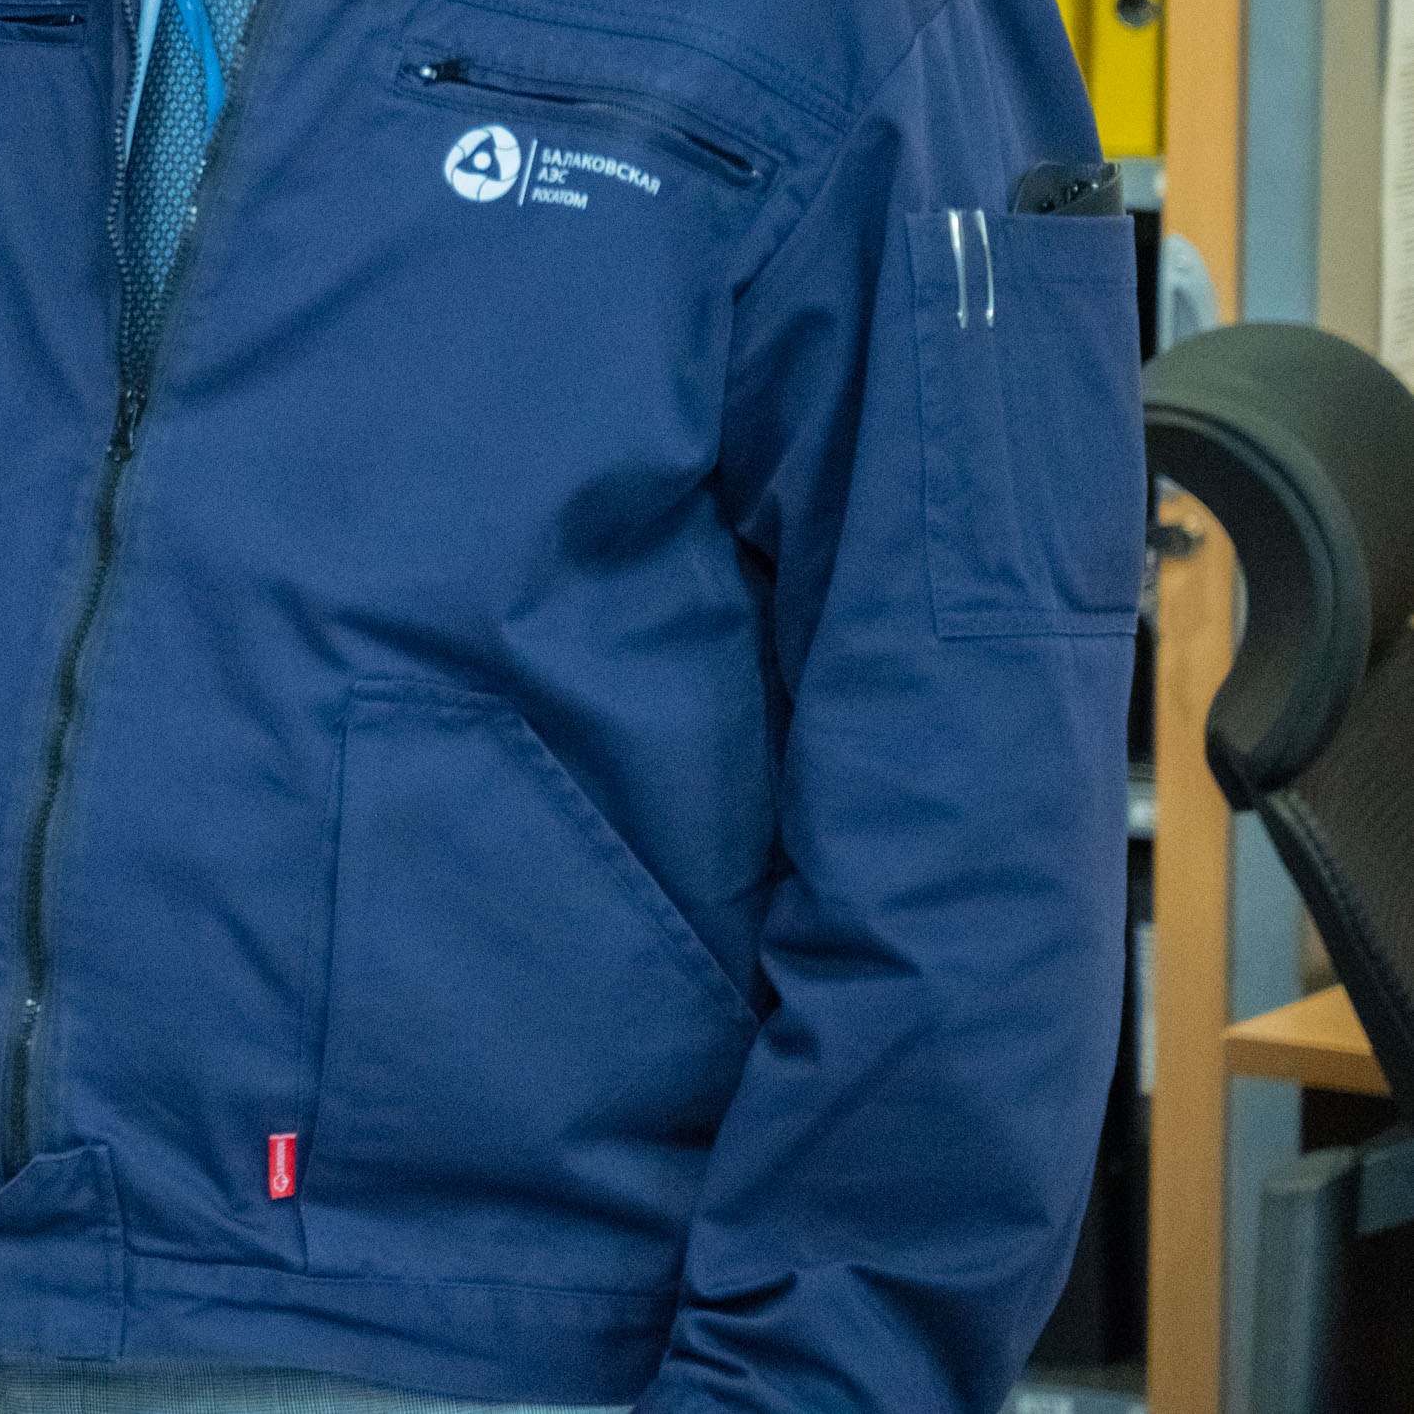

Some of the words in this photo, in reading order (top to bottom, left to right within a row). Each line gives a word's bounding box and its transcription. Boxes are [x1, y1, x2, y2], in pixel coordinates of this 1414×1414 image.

[537, 166, 569, 184] АЭС
[541, 148, 661, 196] БАЛАКОВСКАЯ
[532, 187, 588, 210] РОСАТОМ
